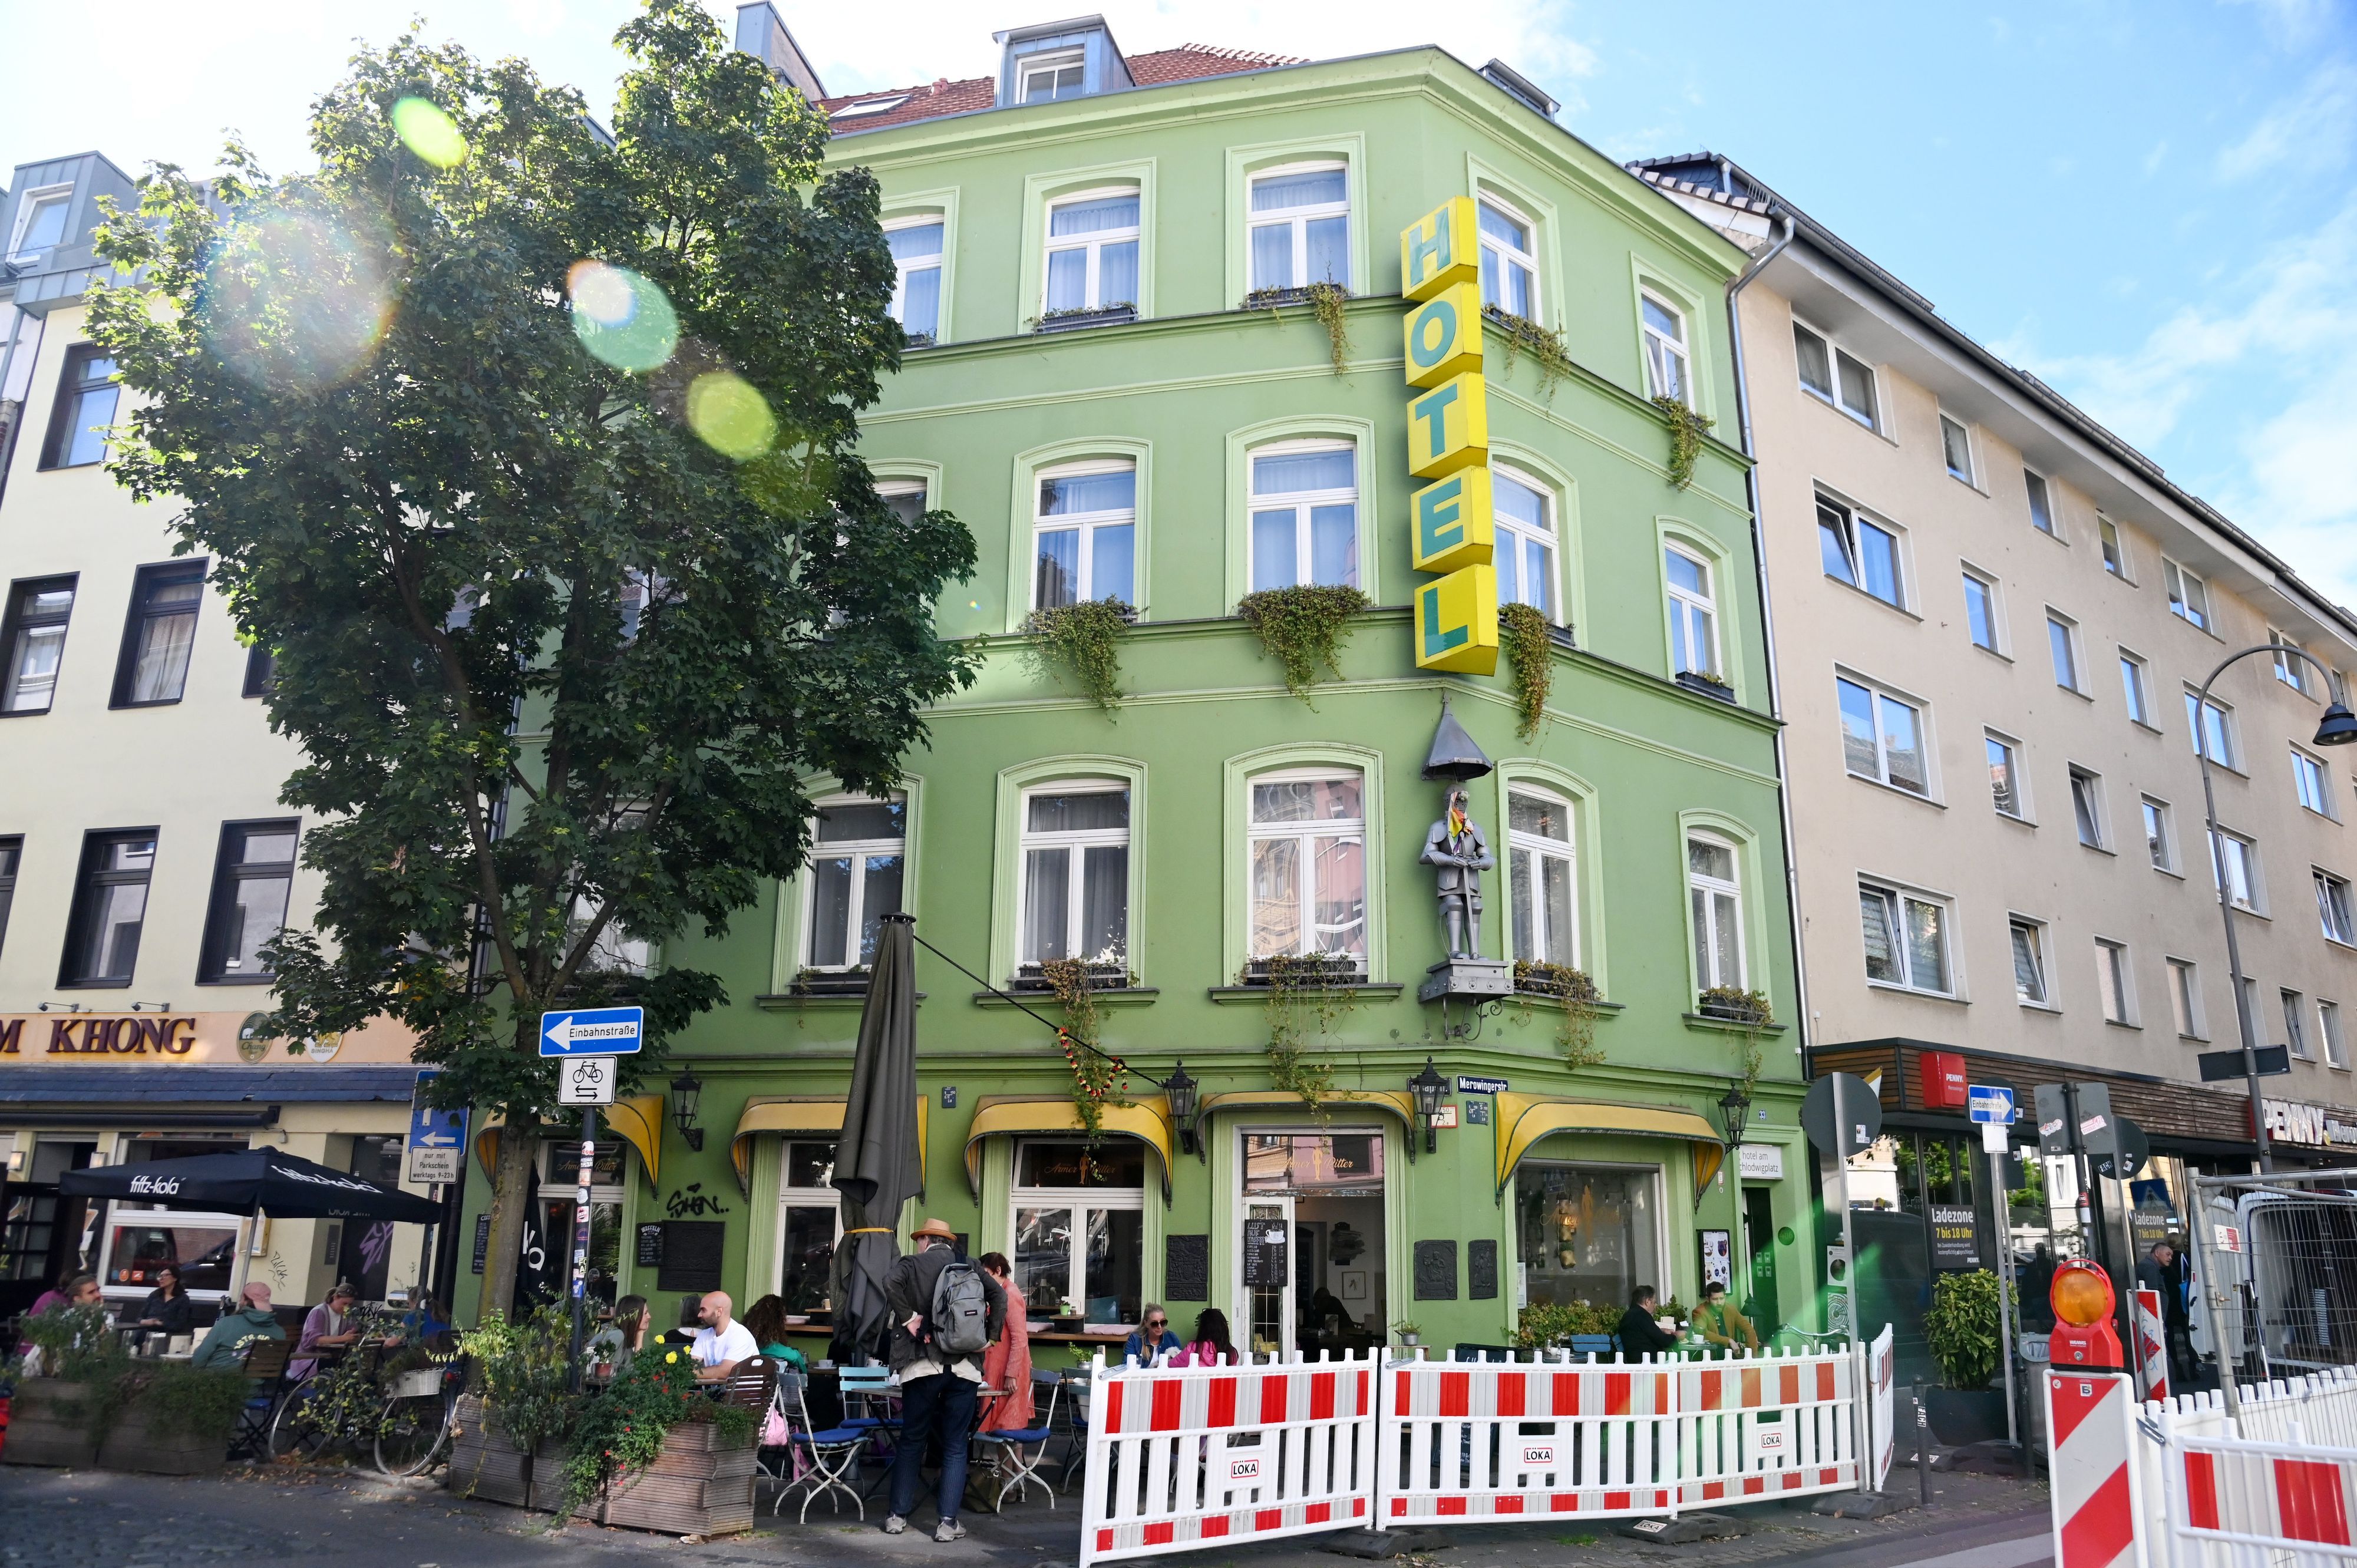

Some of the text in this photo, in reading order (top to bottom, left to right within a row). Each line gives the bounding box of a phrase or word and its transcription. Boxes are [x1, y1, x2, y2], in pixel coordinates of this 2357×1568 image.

[1409, 207, 1468, 658] HOTEL
[46, 1018, 196, 1054] KHONG
[569, 1025, 635, 1038] Einbahnstraße
[1972, 1100, 2002, 1109] Einbahnstraße
[1759, 1110, 1765, 1119] 33
[1742, 1151, 1757, 1160] hotel
[1324, 1156, 1354, 1170] Ritter
[130, 1175, 179, 1196] fritz-kola
[1932, 1207, 1974, 1223] Ladezone
[2134, 1212, 2165, 1225] Ladezone
[1936, 1226, 1972, 1238] 7 bis 18 Uhr
[2138, 1229, 2141, 1238] 7
[2149, 1229, 2155, 1238] 18
[2156, 1229, 2164, 1238] Uhr
[1763, 1434, 1780, 1445] LÖKA
[1526, 1447, 1550, 1460] LÖKA
[1233, 1460, 1256, 1475] LÖKA
